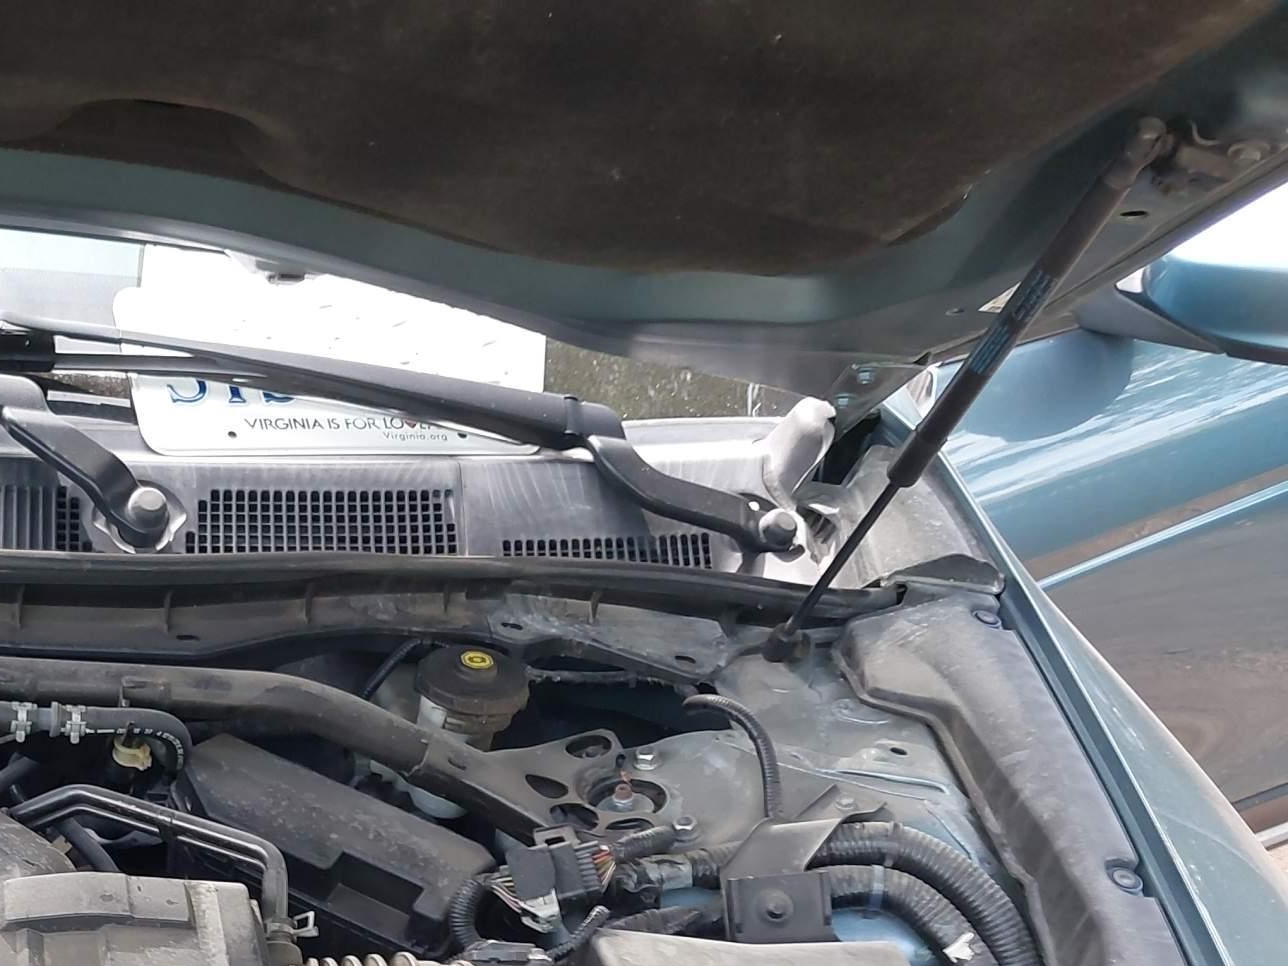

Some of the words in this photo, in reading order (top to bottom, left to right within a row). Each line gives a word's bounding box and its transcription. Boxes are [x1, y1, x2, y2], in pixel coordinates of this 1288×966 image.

[244, 417, 325, 430] VIRGINIA
[327, 418, 341, 430] IS
[344, 418, 380, 430] FOR
[383, 431, 448, 441] Virginia.org
